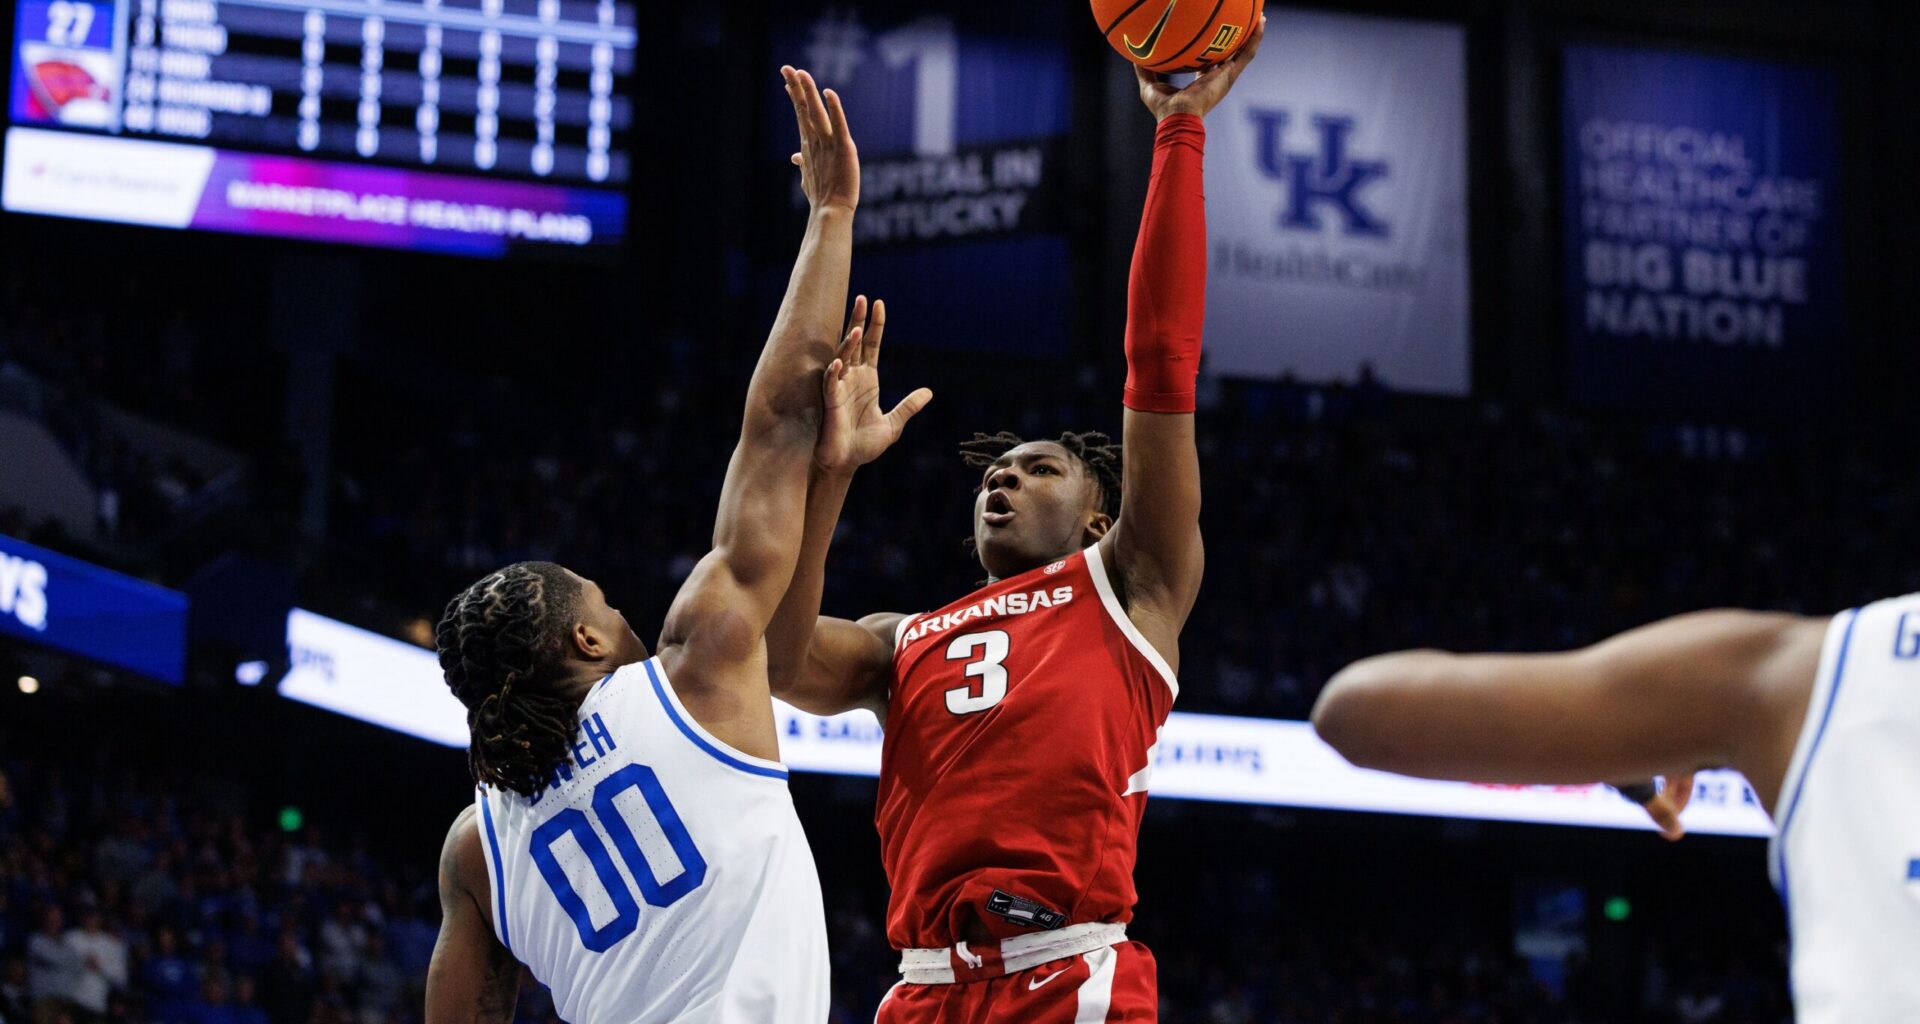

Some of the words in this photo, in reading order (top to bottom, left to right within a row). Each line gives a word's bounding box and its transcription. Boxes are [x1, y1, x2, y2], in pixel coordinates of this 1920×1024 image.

[46, 0, 95, 47] 27
[1580, 118, 1751, 167] OFFICIAL
[858, 154, 989, 203] SPITAL
[993, 147, 1042, 189] IN
[1247, 107, 1391, 237] UK
[1580, 160, 1820, 219] HEALTHCARE
[226, 180, 407, 226] MARKETPLACE
[409, 198, 509, 234] HEALTH
[509, 208, 592, 245] PLANS
[854, 192, 1028, 241] NTUCKY
[1581, 198, 1753, 248] PARTNER
[1756, 212, 1808, 254] OF
[1586, 240, 1673, 291] BIG
[1682, 248, 1807, 305] BLUE
[1585, 289, 1784, 347] NATION
[902, 586, 1073, 650] ARKANSAS
[945, 629, 1011, 716] 3
[529, 762, 708, 954] 00
[1039, 912, 1054, 922] 46
